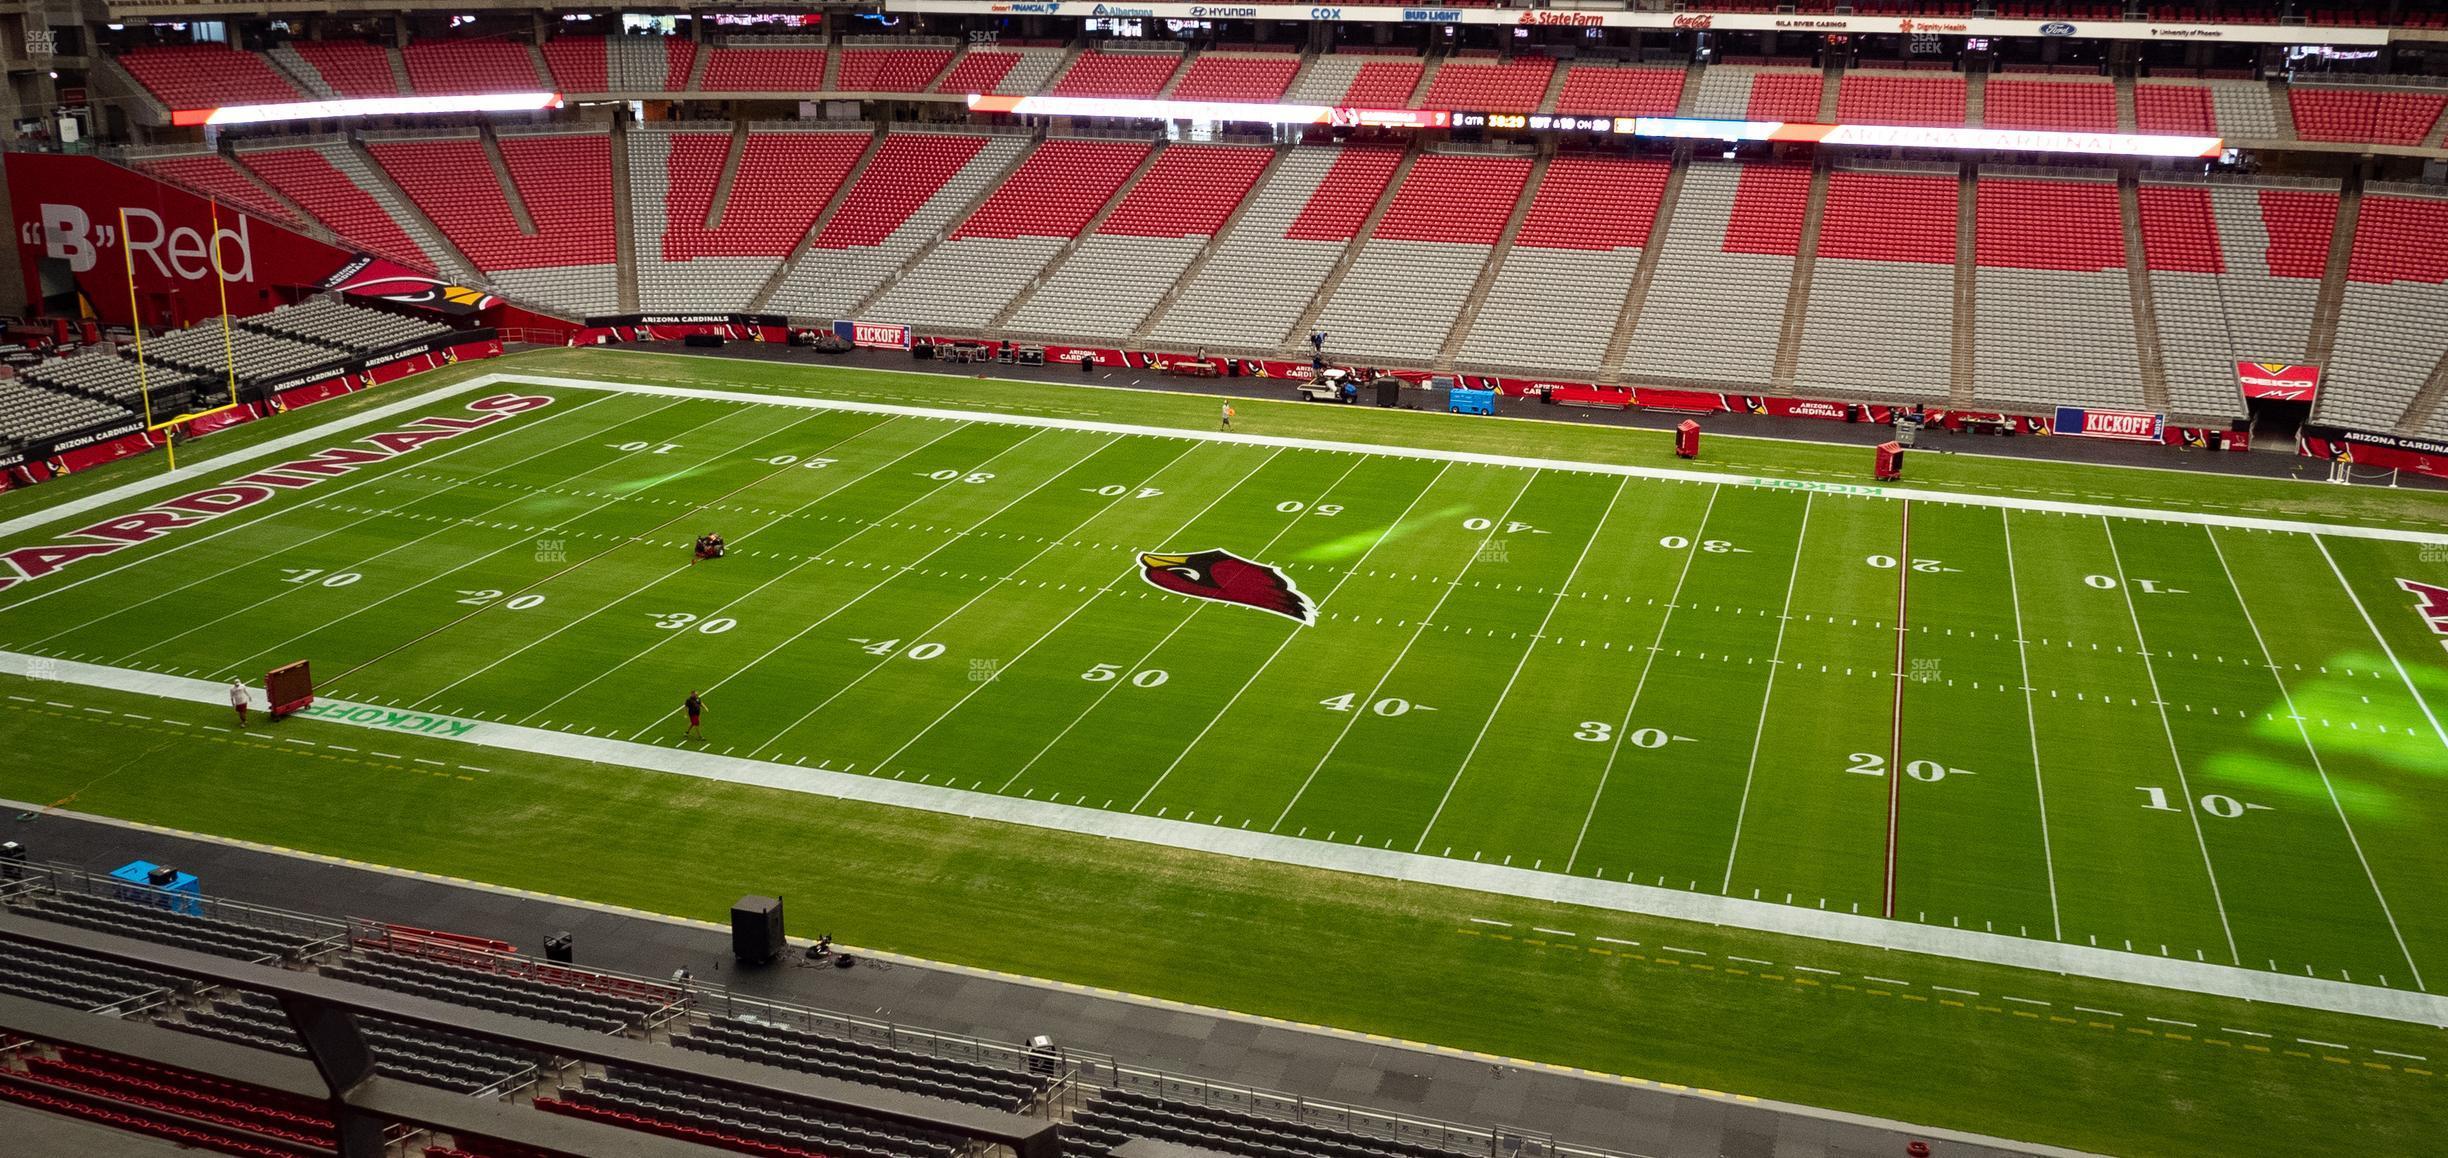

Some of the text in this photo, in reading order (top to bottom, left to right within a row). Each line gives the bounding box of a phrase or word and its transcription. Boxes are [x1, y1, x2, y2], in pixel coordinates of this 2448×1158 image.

[1208, 7, 1257, 17] HYUNDAI
[1311, 8, 1341, 20] COX
[1405, 11, 1460, 22] BUD LIGHT
[1917, 23, 1967, 32] Dignity Health
[2043, 23, 2070, 35] Ford
[2159, 28, 2188, 38] University
[1465, 115, 1484, 126] QTR
[1577, 119, 1592, 130] ON
[1840, 128, 2139, 151] ARIZONA CARDINALS
[119, 207, 254, 283] Red
[642, 315, 729, 324] ARIZONA CARDINALS
[856, 326, 901, 344] KICKOFF
[365, 344, 429, 367] ARIZONA CARDINALS
[274, 367, 345, 392] ARIZONA CARDINALS
[2240, 375, 2314, 389] GEICO
[1789, 406, 1844, 418] CARDINALS
[1800, 402, 1834, 410] ARIZONA
[2086, 413, 2150, 435] KICKOFF
[54, 422, 145, 452] ARIZONA CARDINALS
[2344, 431, 2396, 446] ARIZONA
[0, 393, 556, 592] ARDINALS
[300, 703, 478, 737] KICKOFF
